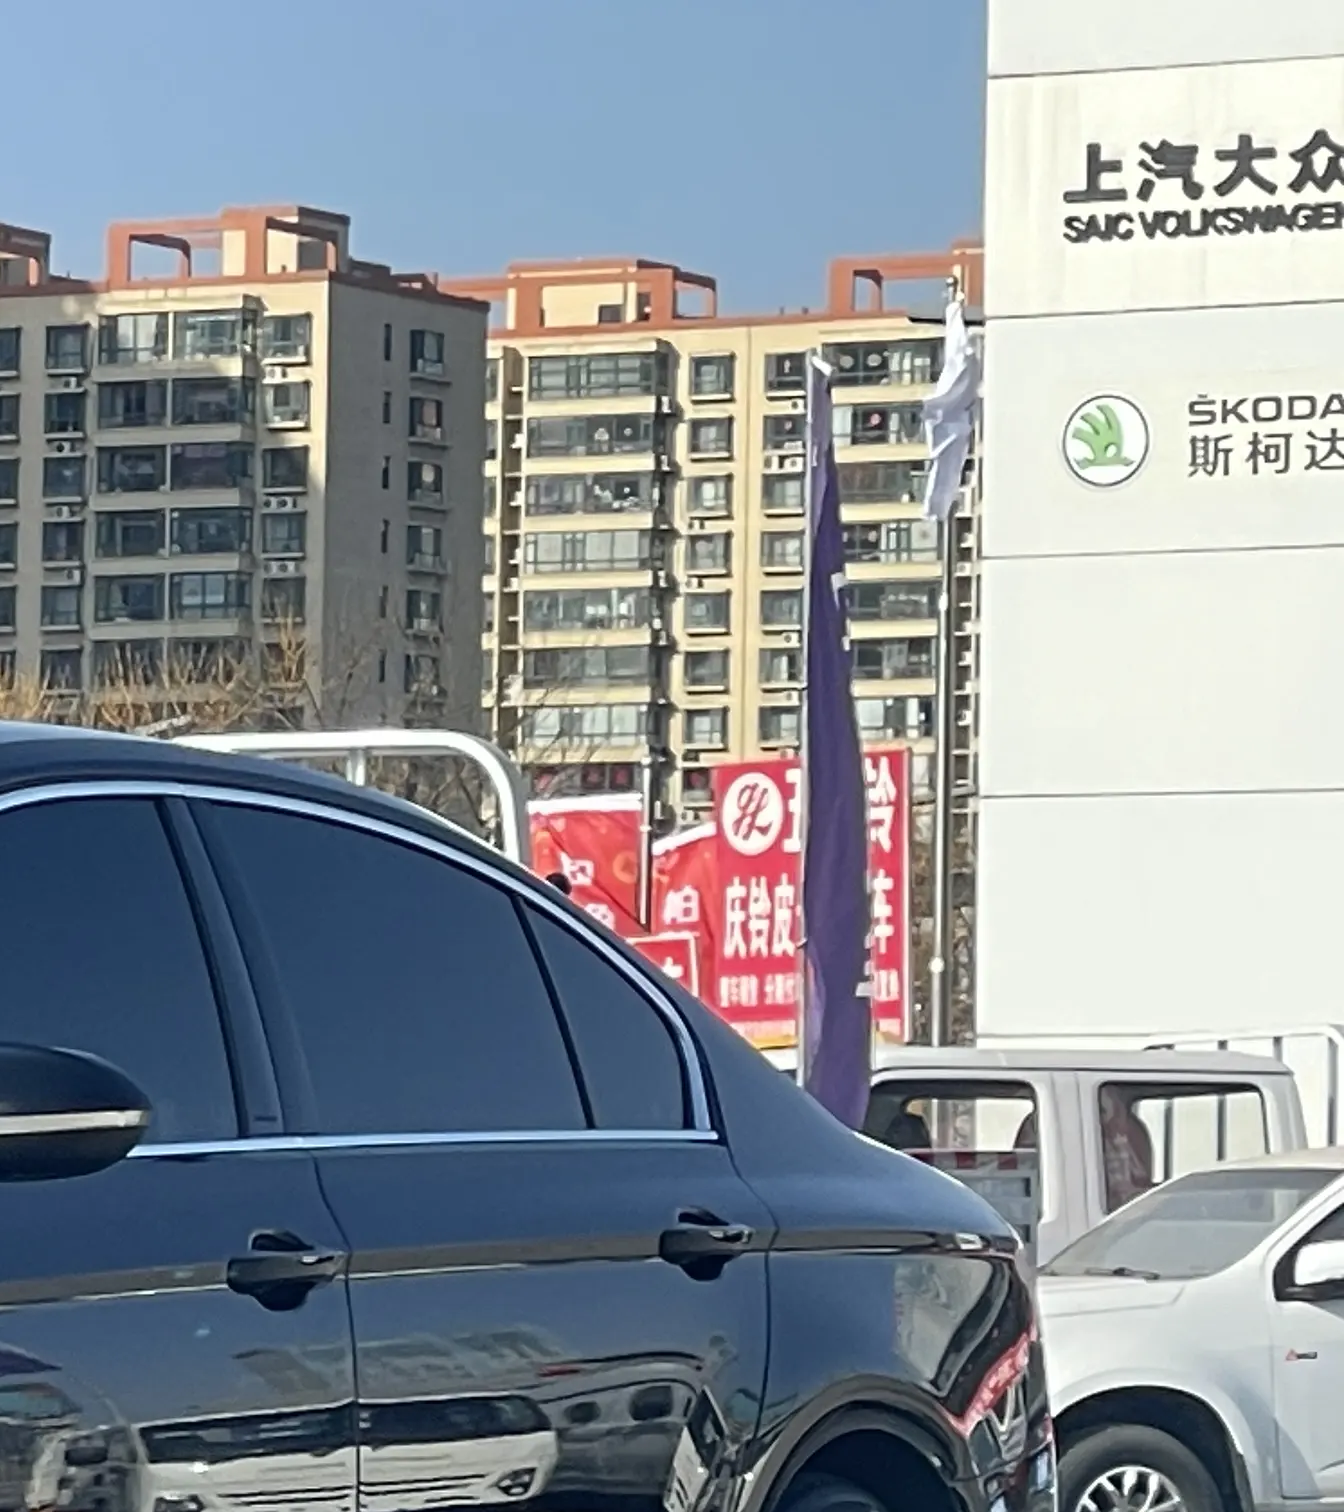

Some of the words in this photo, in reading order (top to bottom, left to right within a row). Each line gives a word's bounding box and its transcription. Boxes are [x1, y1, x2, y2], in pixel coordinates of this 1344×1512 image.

[1063, 128, 1344, 204] 上汽大众
[1063, 212, 1135, 243] SAIC
[1188, 428, 1344, 478] 斯柯达
